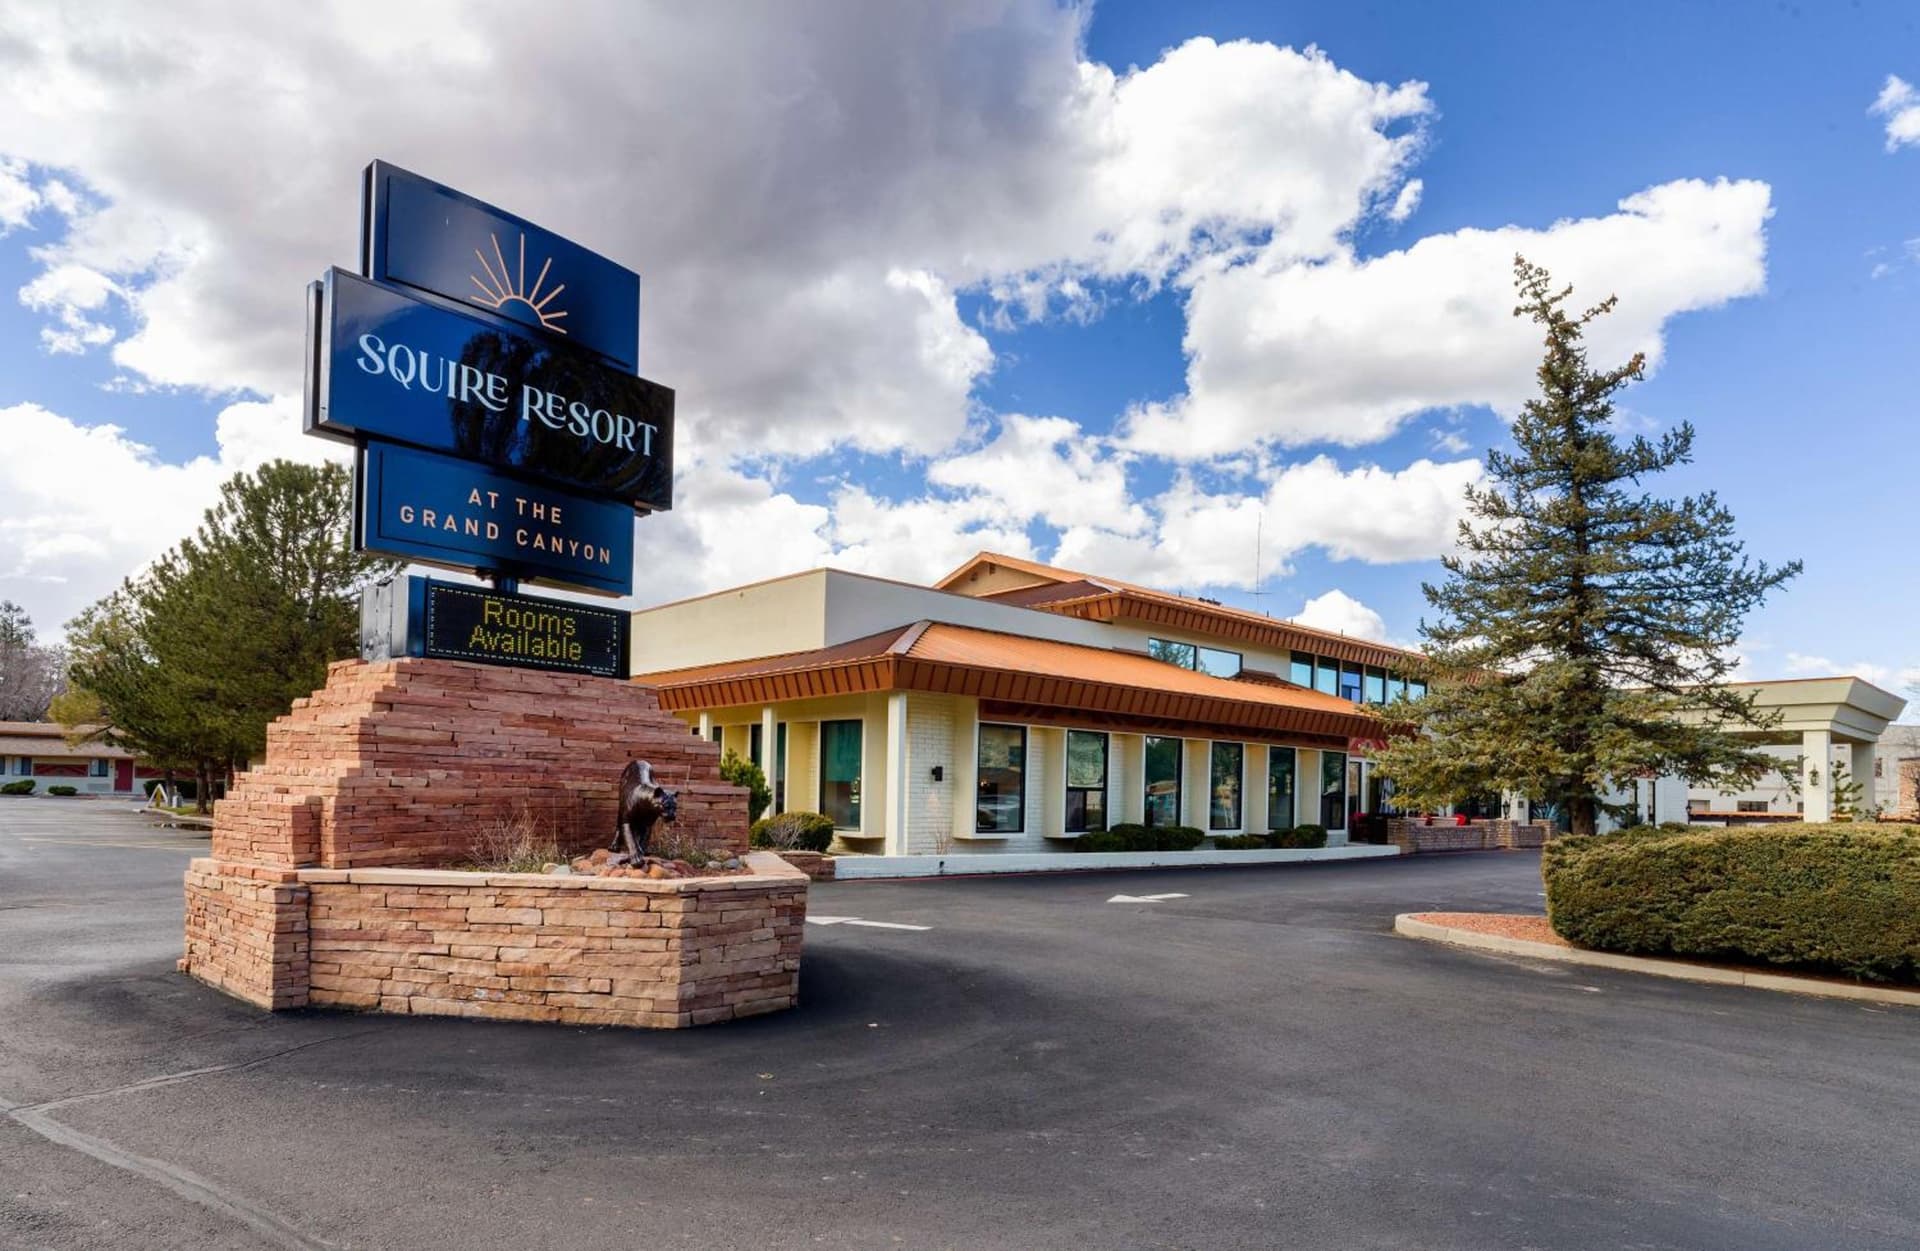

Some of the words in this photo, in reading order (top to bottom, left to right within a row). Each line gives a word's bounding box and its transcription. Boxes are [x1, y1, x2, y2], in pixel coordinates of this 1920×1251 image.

[357, 333, 508, 412] SQUIRE
[522, 384, 658, 457] RESORT
[468, 488, 499, 509] AT
[516, 498, 561, 524] THE
[400, 505, 499, 540] GRAND
[516, 529, 610, 565] CANYON
[483, 600, 577, 636] Rooms
[468, 624, 583, 661] Available
